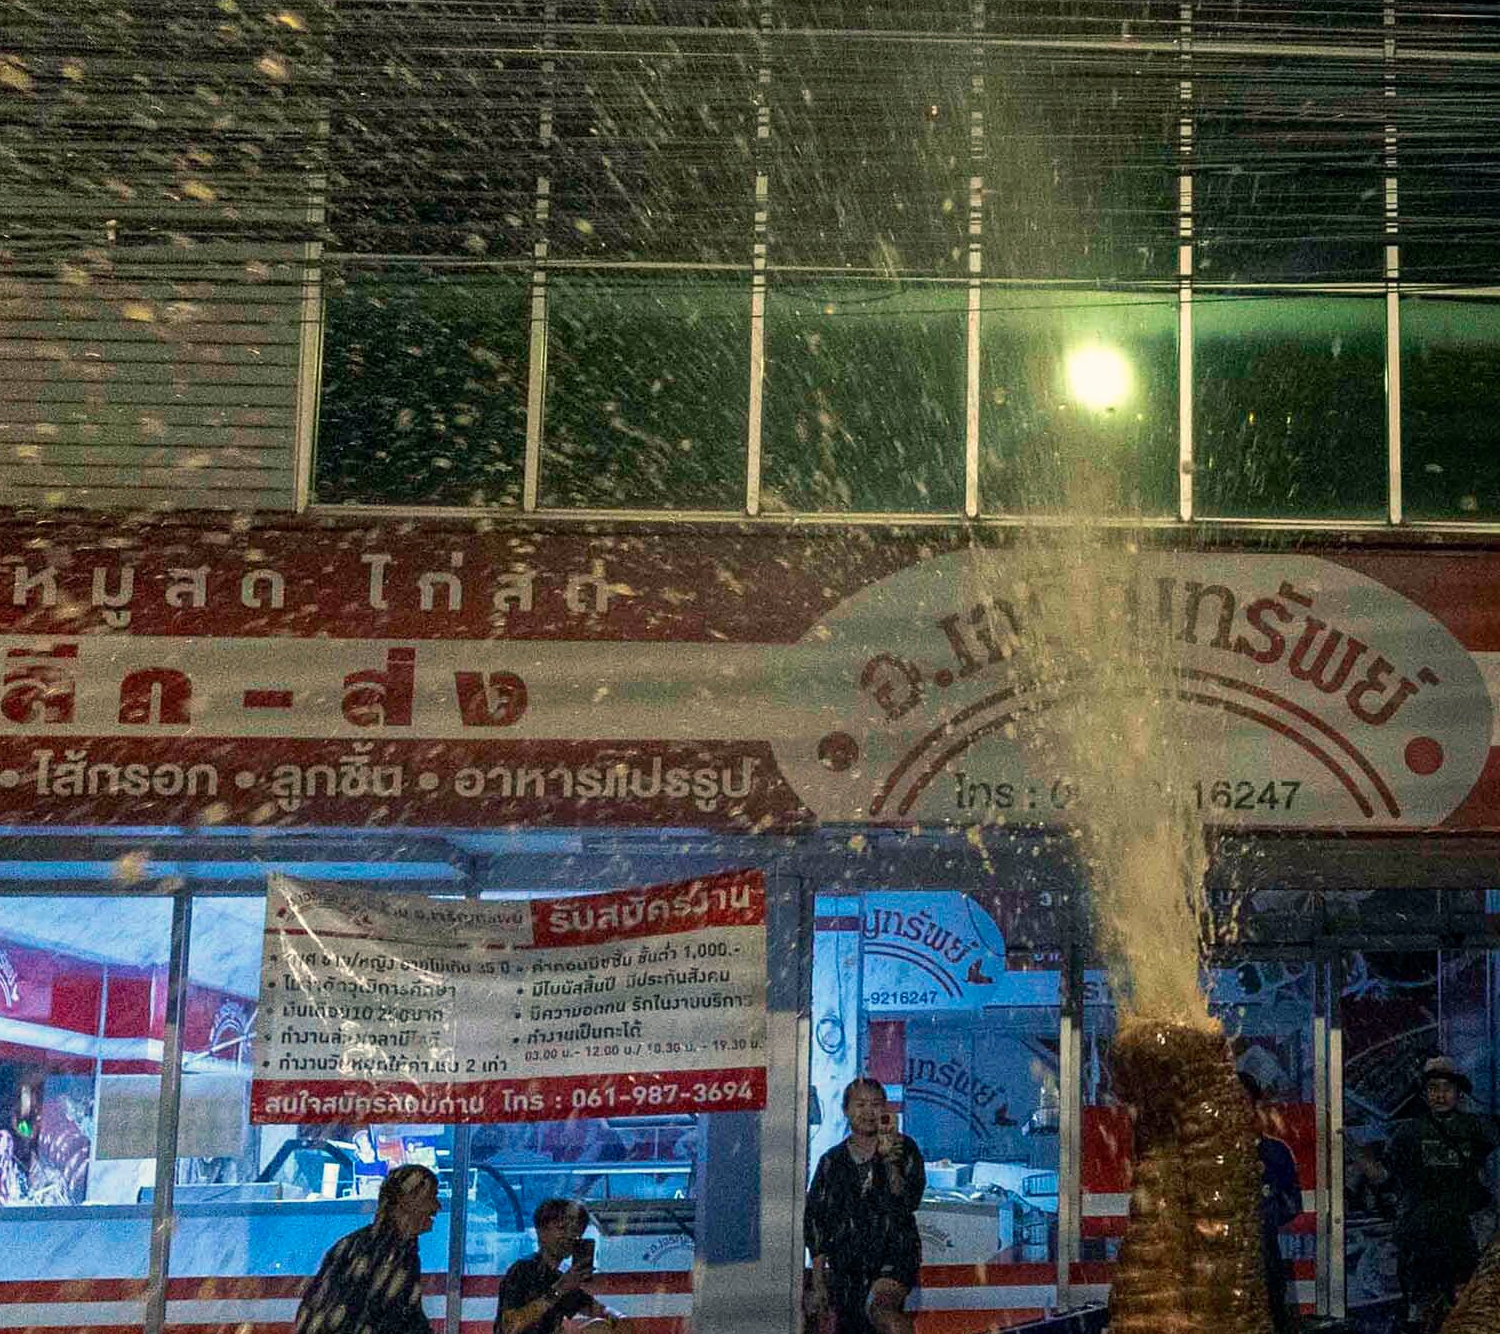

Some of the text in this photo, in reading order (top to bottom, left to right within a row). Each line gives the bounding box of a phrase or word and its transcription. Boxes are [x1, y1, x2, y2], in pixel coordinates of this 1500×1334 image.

[11, 551, 611, 629] หมูสด ไก่สด
[33, 746, 219, 798] ไส้กรอก
[271, 741, 403, 812] ลูกชิ้น
[454, 755, 758, 813] อาหารแปรรูป
[549, 882, 752, 934] รับสมัครงาน
[683, 942, 741, 962] 1,000.-
[571, 1082, 754, 1108] 061-987-3694
